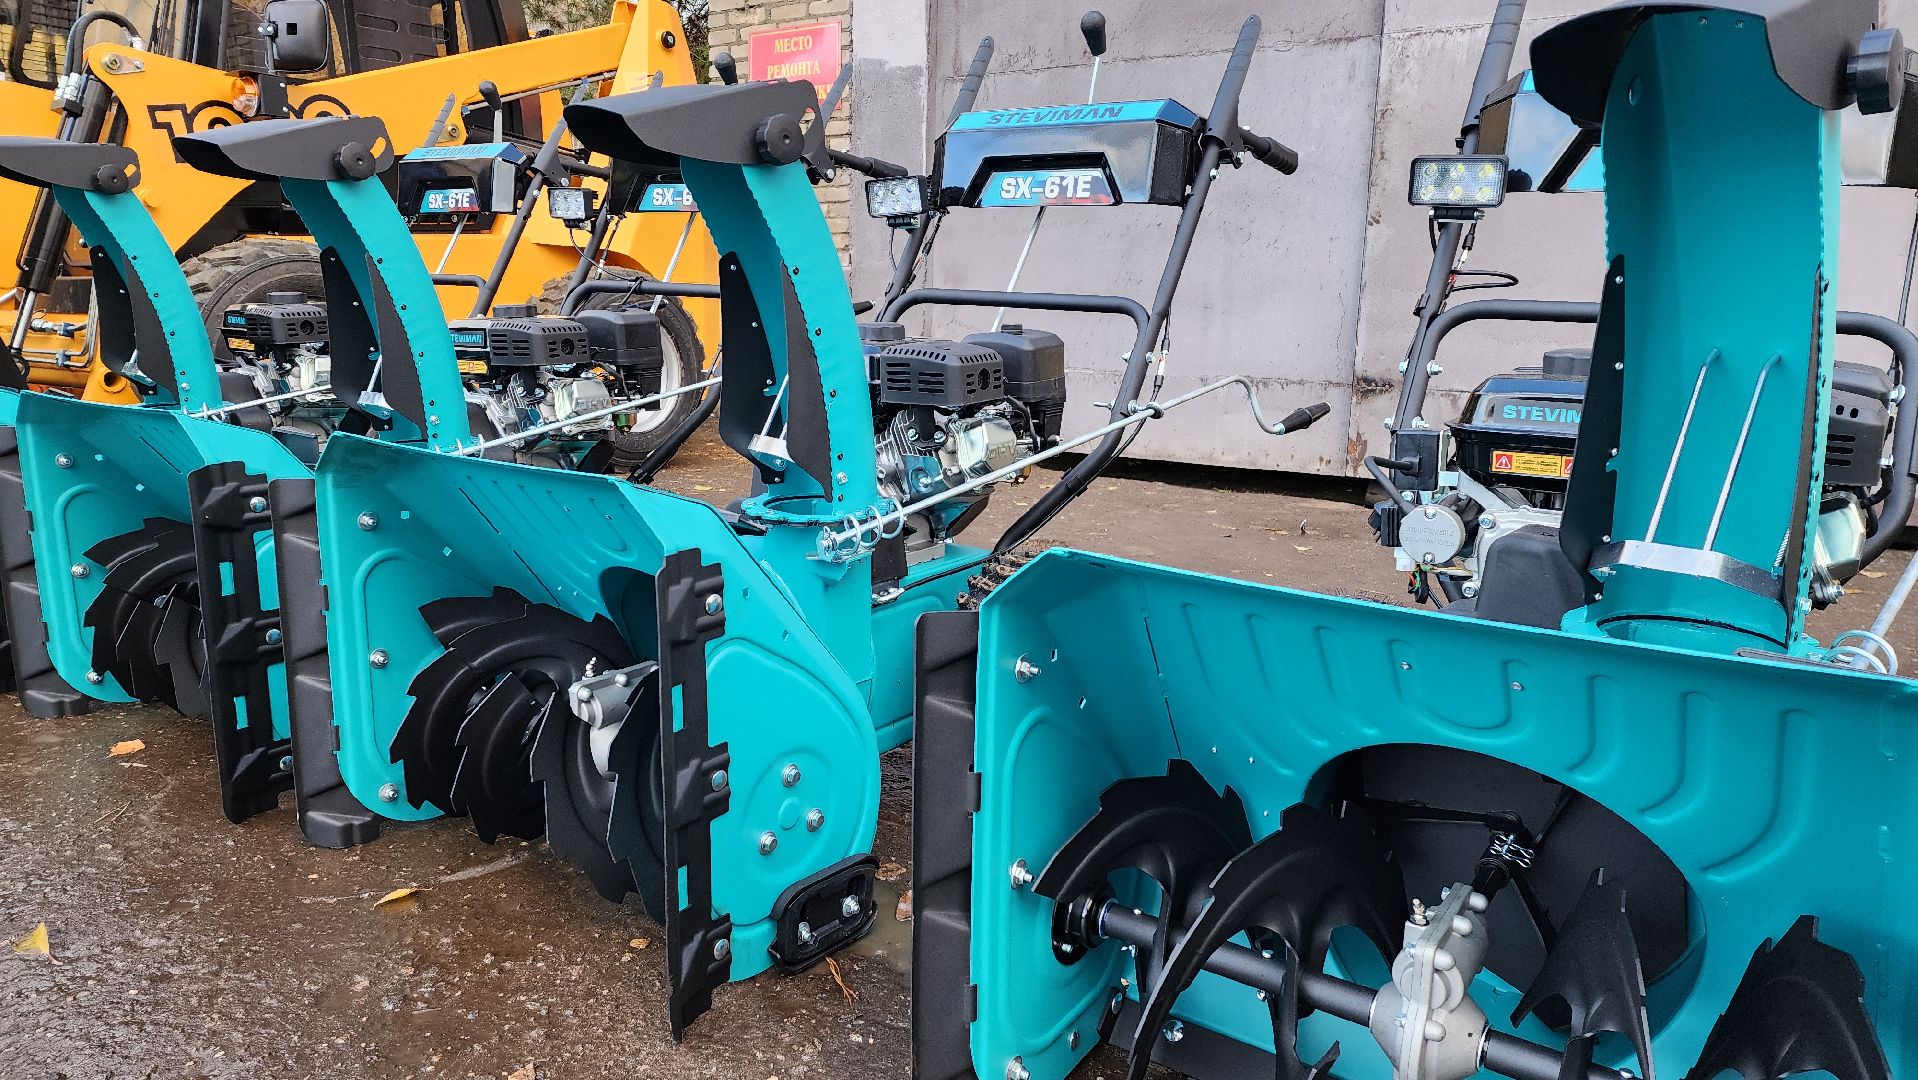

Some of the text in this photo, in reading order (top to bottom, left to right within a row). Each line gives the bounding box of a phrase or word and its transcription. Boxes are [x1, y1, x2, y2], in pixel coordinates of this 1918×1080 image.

[774, 35, 813, 54] МЕСТО
[767, 61, 820, 80] РЕМОНТА
[986, 106, 1125, 125] STEVIMAN
[653, 187, 693, 206] SX-6
[1000, 175, 1093, 200] SX-61E
[428, 192, 471, 209] SX-61E
[450, 333, 482, 343] TEVIMAN
[1502, 404, 1581, 424] STEVIM
